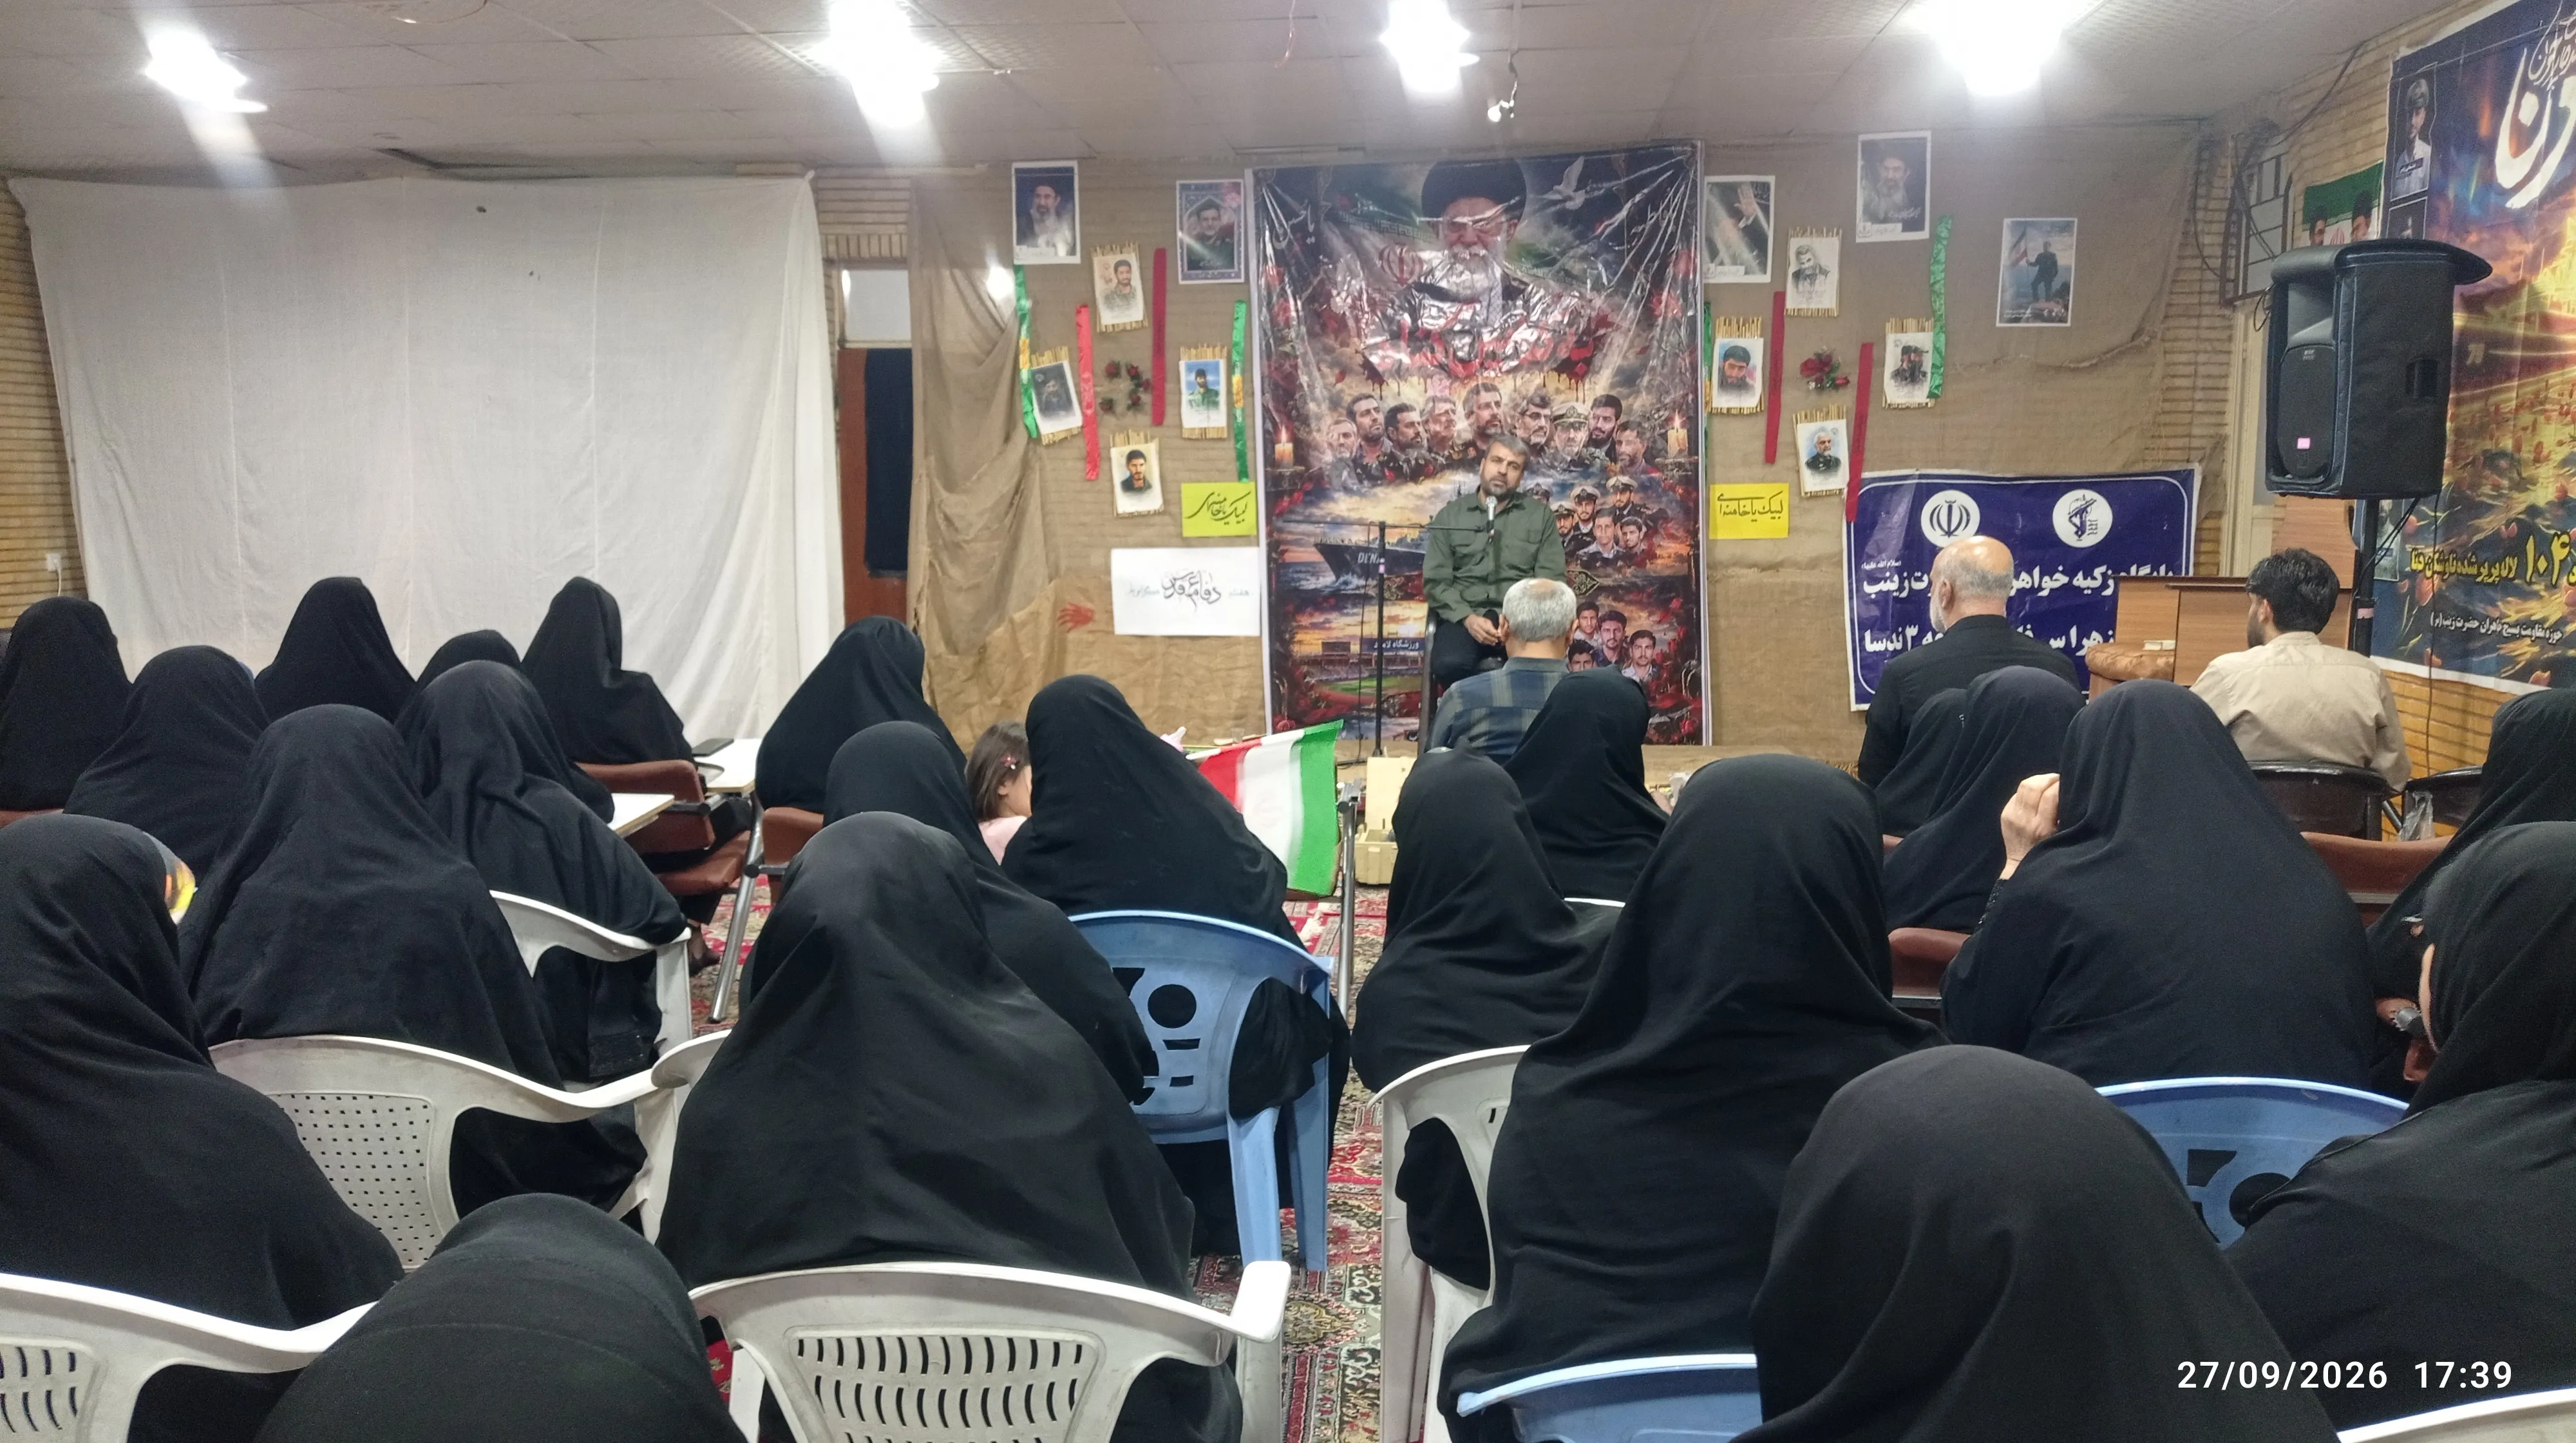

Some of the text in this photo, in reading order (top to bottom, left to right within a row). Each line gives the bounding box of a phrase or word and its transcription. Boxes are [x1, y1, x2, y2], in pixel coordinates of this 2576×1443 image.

[1757, 490, 1783, 520] لبیک
[2525, 534, 2571, 586] ۱۰۴
[1863, 571, 1909, 598] زینب
[2456, 616, 2479, 631] حضرت
[2503, 622, 2521, 637] بسیج
[2521, 623, 2545, 640] مقاومت
[2545, 627, 2563, 644] حوزه
